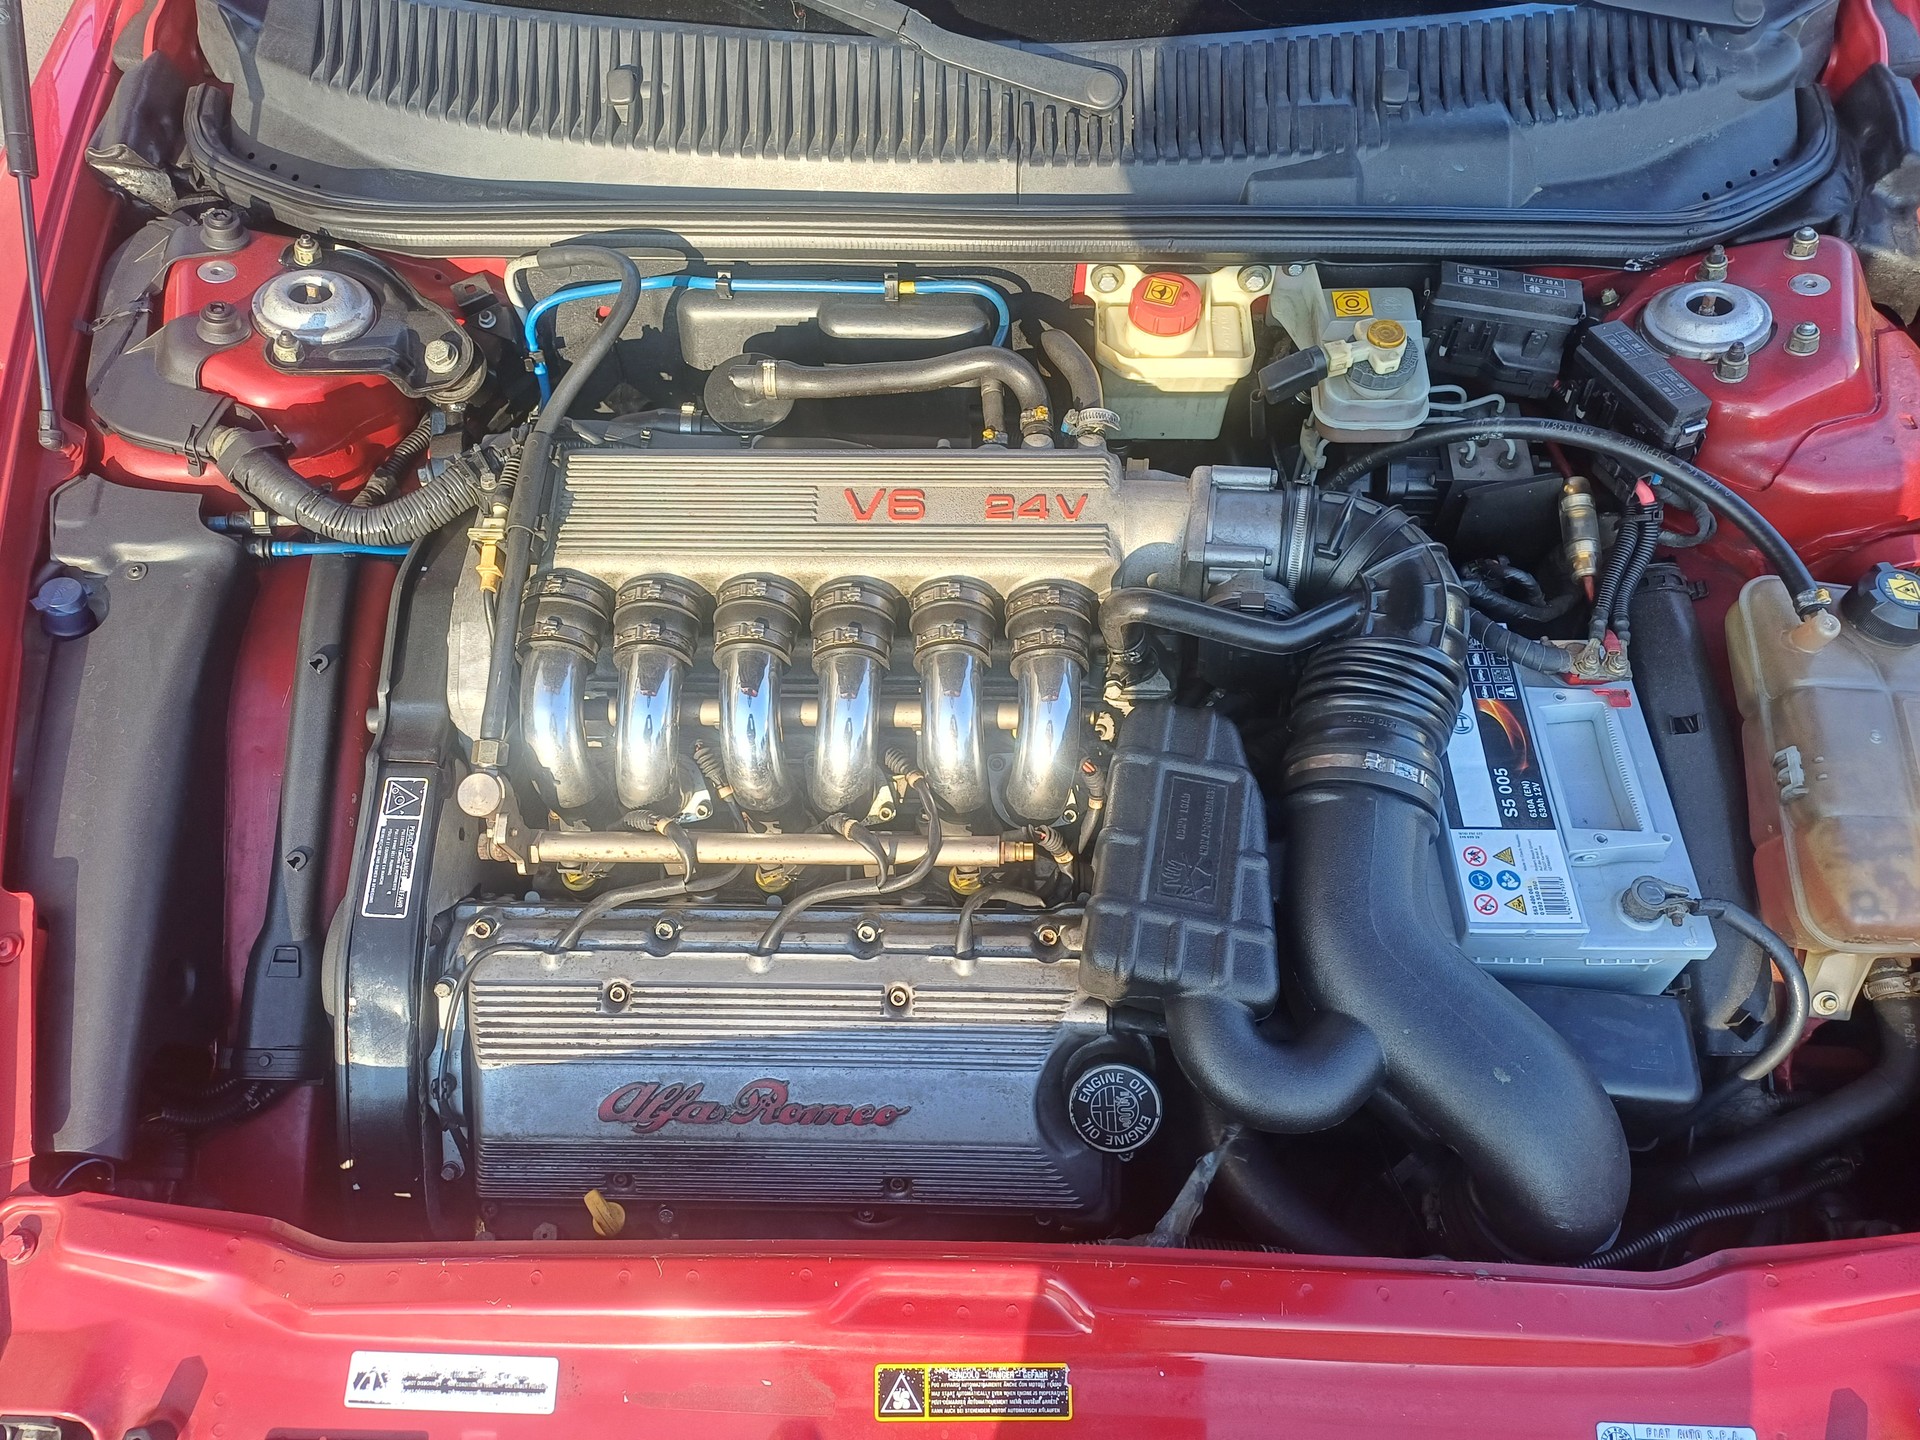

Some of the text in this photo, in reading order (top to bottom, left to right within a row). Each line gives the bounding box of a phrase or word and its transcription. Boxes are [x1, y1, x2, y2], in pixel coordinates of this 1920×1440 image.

[844, 488, 926, 521] V6
[984, 492, 1088, 521] 24V
[1494, 768, 1518, 817] S5 005
[1521, 781, 1537, 817] 610A (EN)
[1532, 782, 1547, 817] 63Ah 12V
[1078, 1072, 1148, 1103] ENGINE OIL
[598, 1078, 912, 1134] Alfa Romeo
[1082, 1115, 1151, 1145] ENGINE OIL
[1646, 1428, 1670, 1438] FIAT
[1678, 1428, 1702, 1440] AUTO
